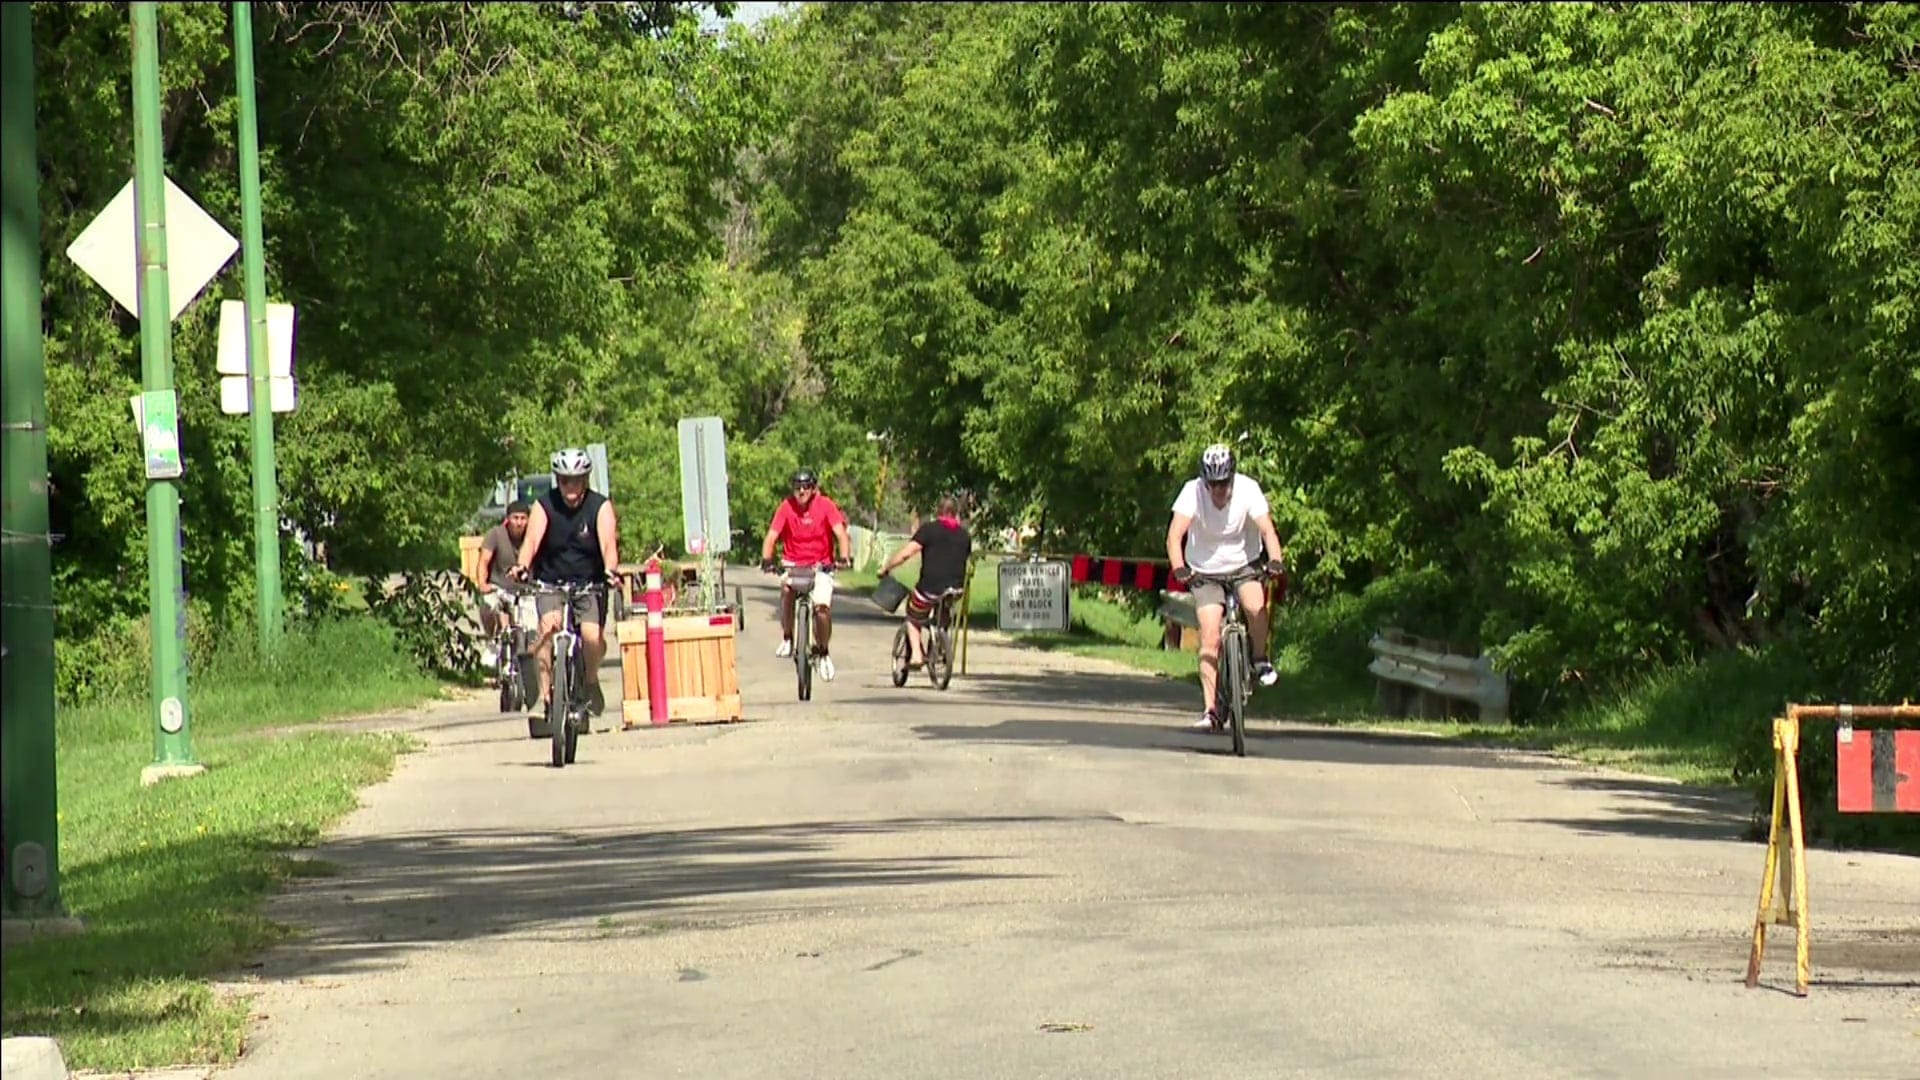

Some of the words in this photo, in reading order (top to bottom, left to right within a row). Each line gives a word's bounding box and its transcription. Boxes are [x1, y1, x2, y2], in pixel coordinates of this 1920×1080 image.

[1001, 566, 1027, 577] MOTOR
[1029, 566, 1060, 577] VEHICLE
[1018, 577, 1044, 587] TRAVEL
[1042, 588, 1053, 599] TO
[1009, 599, 1025, 609] ONE
[1028, 599, 1053, 609] BLOCK
